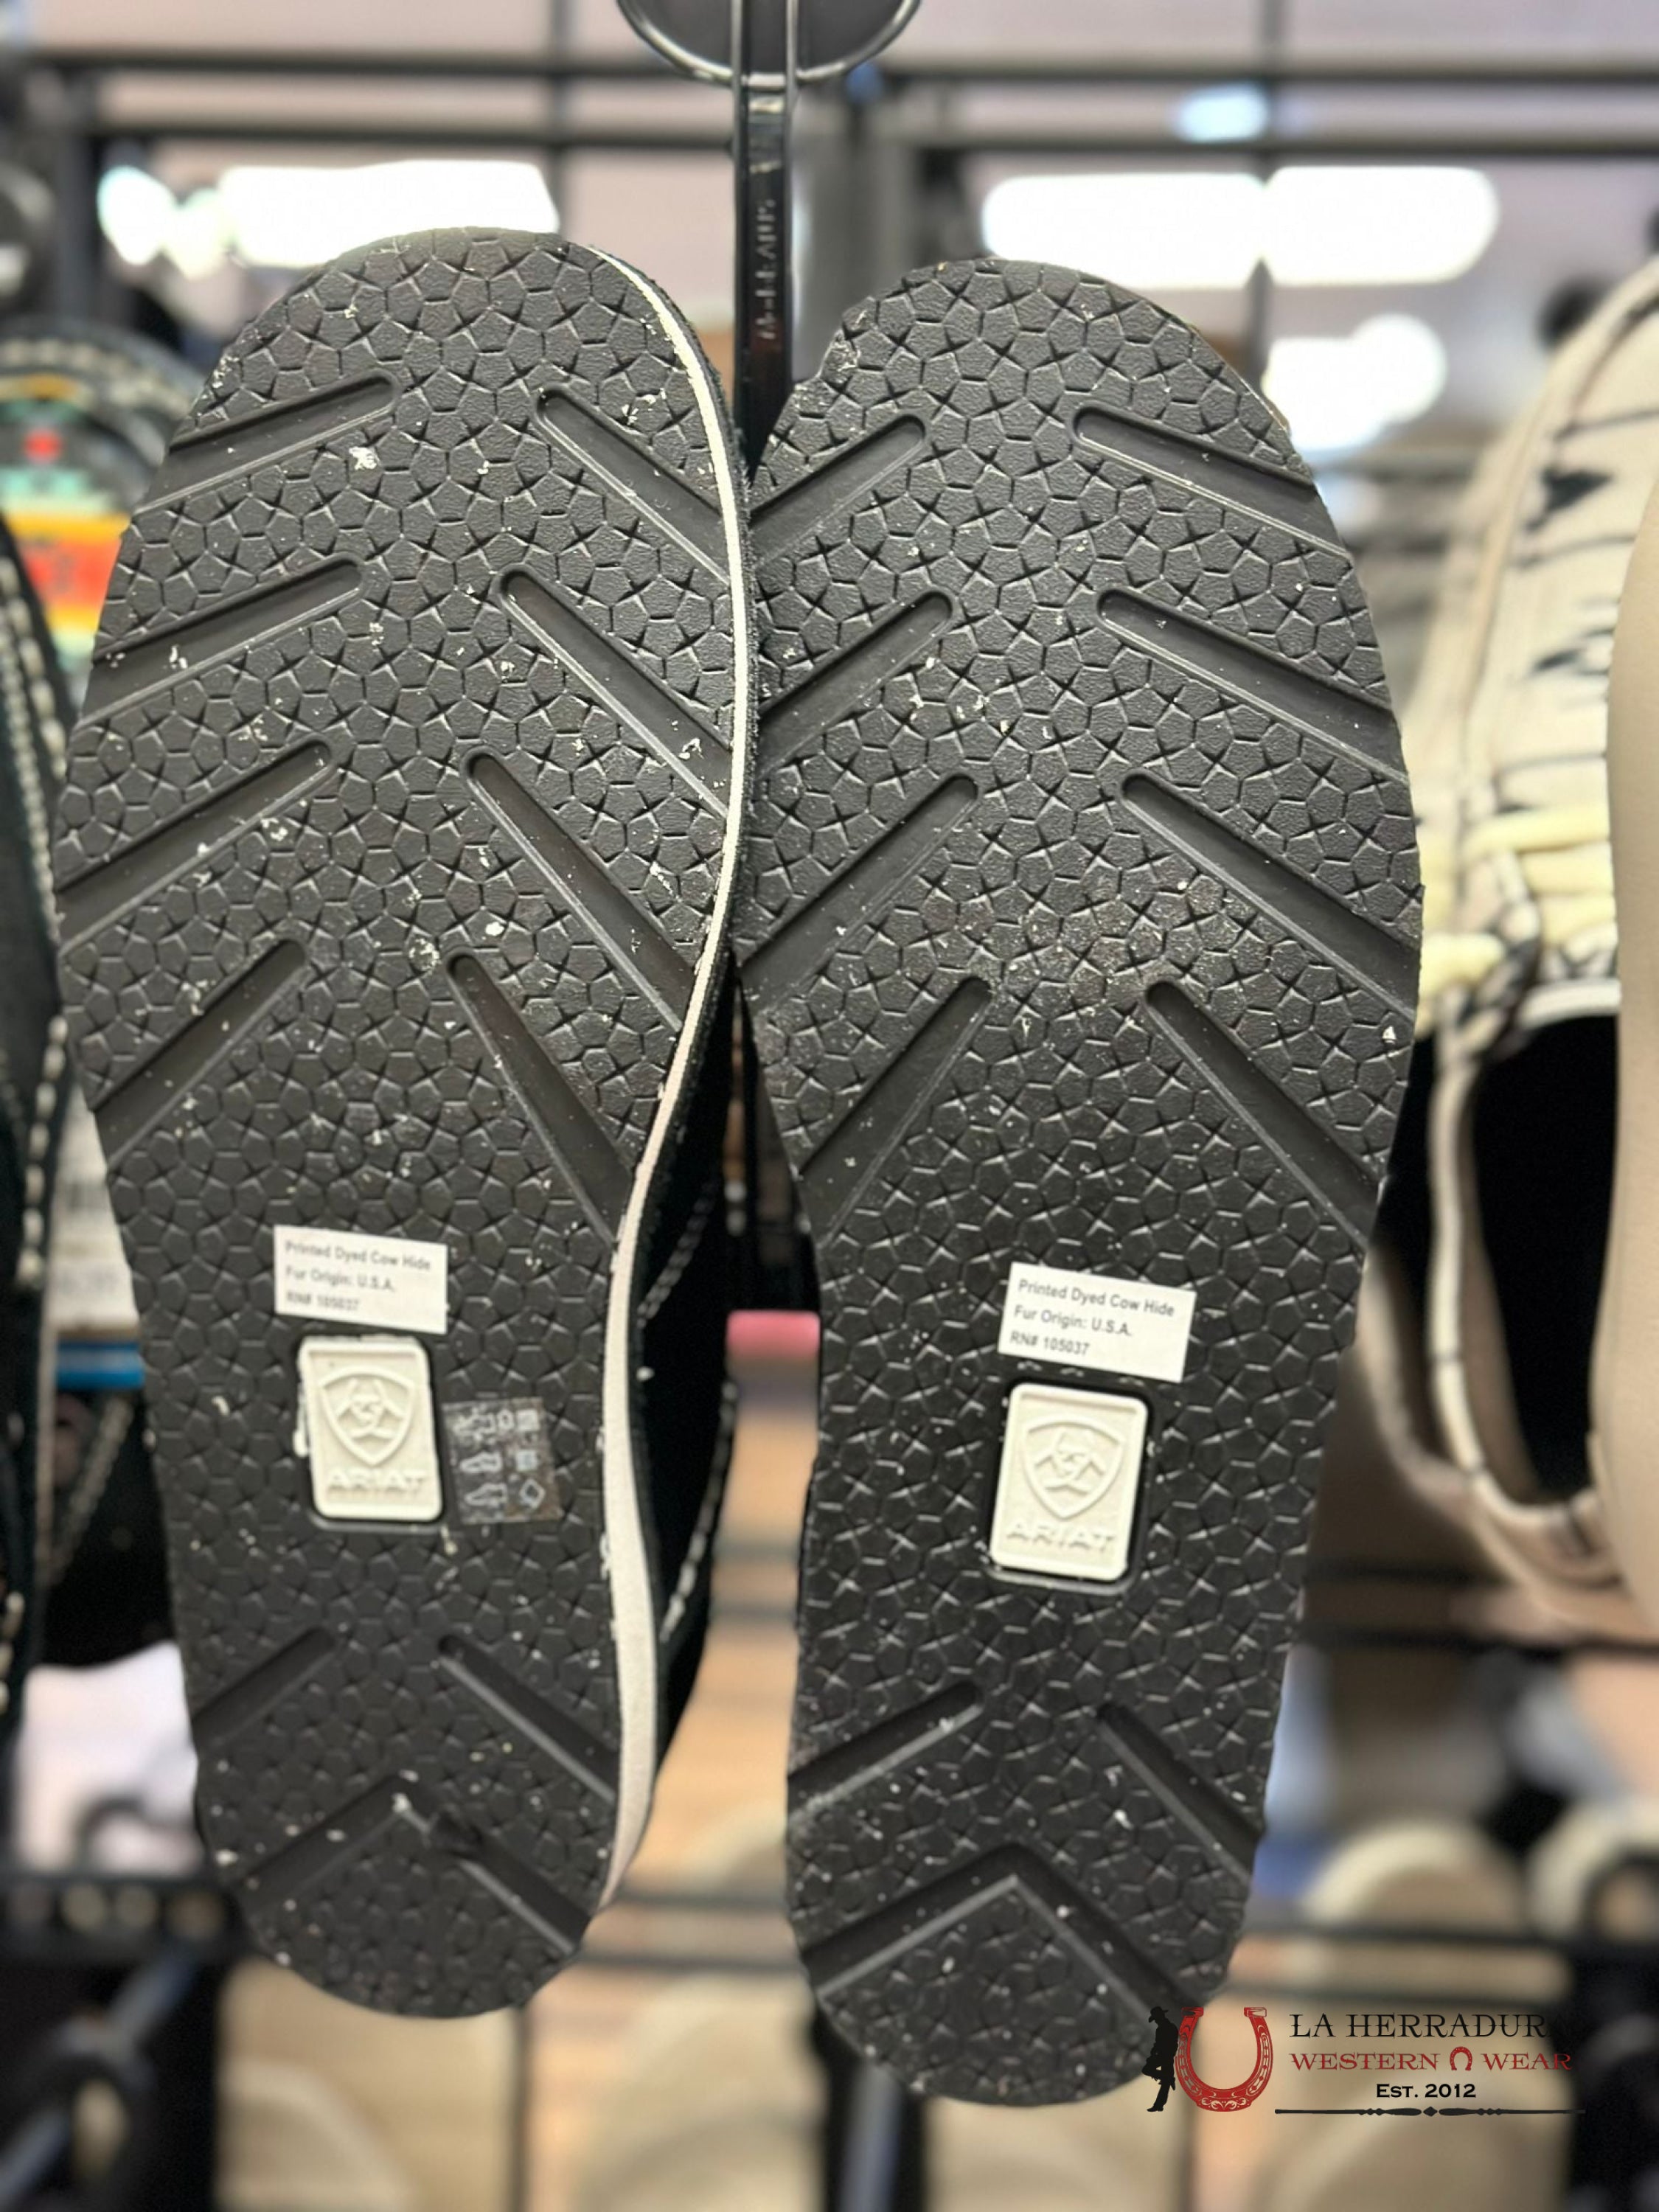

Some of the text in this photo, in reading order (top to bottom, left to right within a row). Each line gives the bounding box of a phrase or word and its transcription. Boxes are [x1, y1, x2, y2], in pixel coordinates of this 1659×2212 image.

[286, 1240, 431, 1270] Printed Dyed Cow Hide
[287, 1267, 307, 1280] Fur
[1018, 1279, 1175, 1318] Printed Dyed Cow Hide
[1014, 1304, 1133, 1336] Fur Origin: U.S.A.
[1010, 1331, 1090, 1355] RN# 105037
[327, 1469, 426, 1495] ARIAT
[1006, 1522, 1116, 1551] ARIAT
